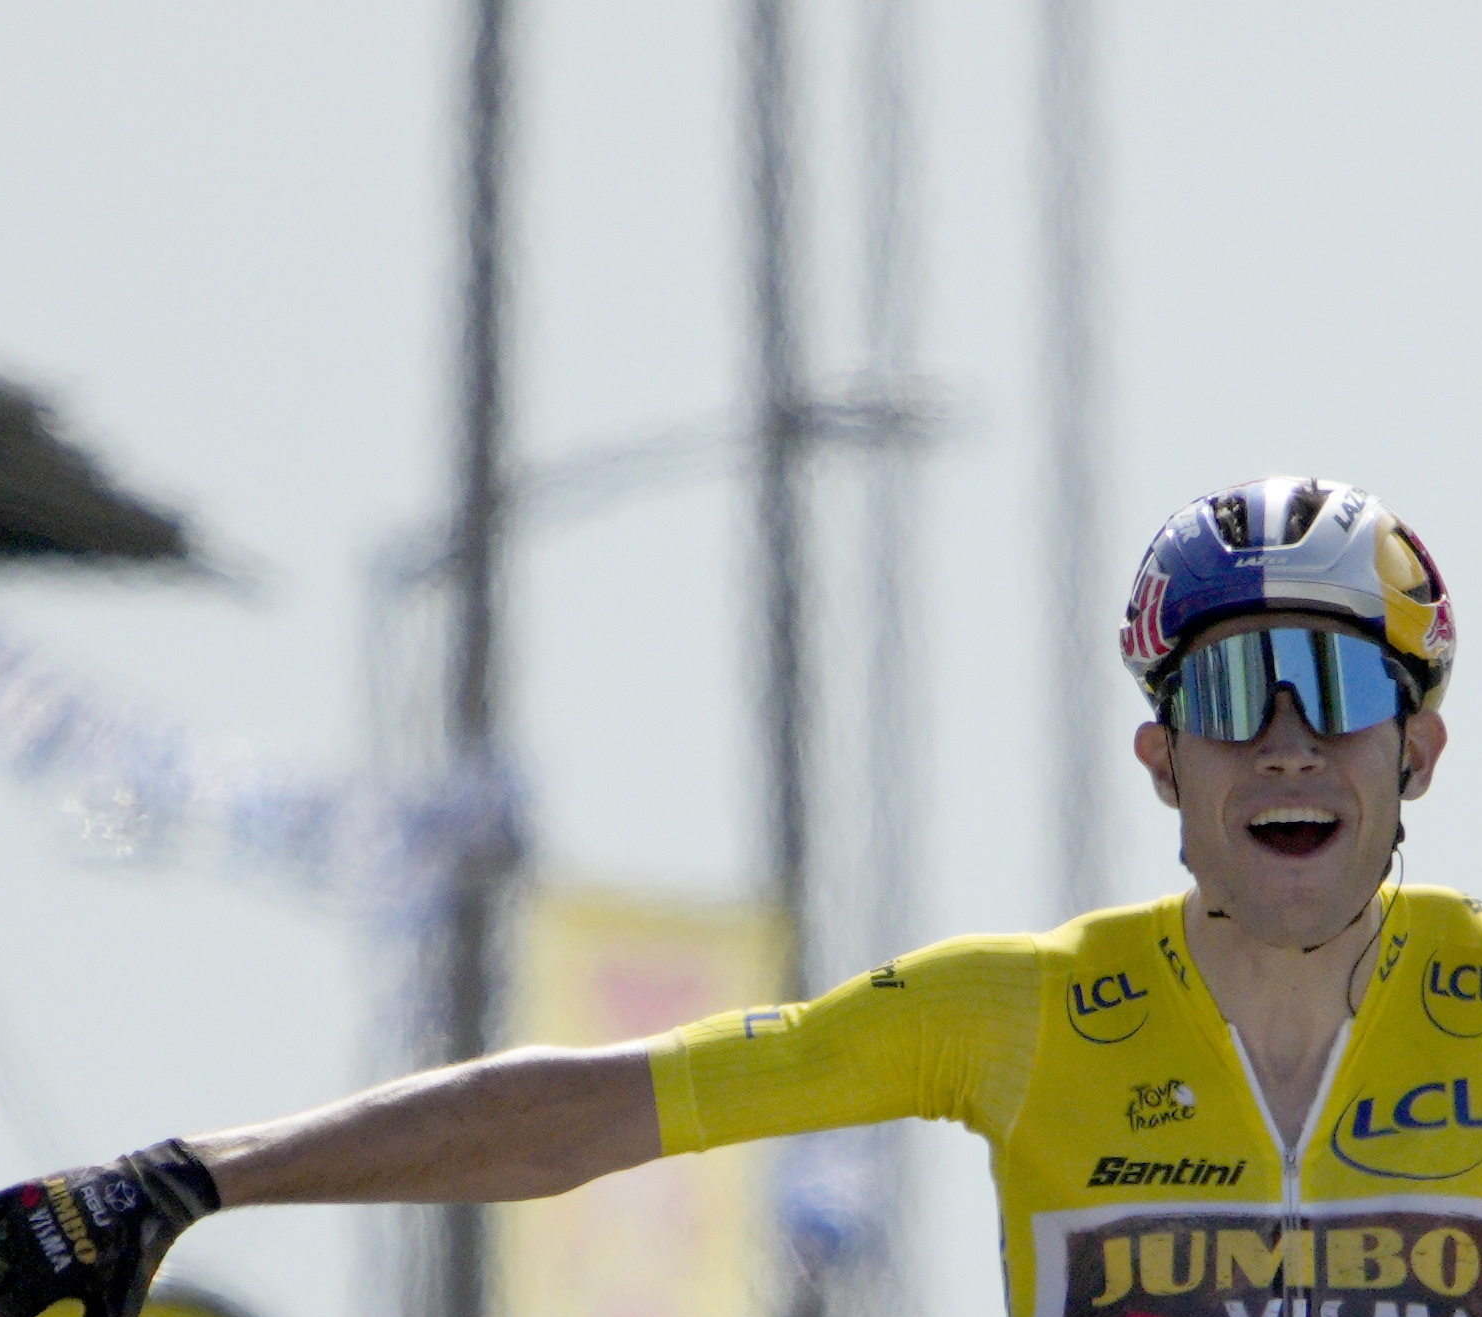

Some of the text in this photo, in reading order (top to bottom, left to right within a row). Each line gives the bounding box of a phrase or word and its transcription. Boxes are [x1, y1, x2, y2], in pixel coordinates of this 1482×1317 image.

[1073, 972, 1148, 1017] LCL
[1087, 1156, 1247, 1187] Santini
[43, 1179, 98, 1265] JUMBO
[1091, 1226, 1481, 1307] JUMBO
